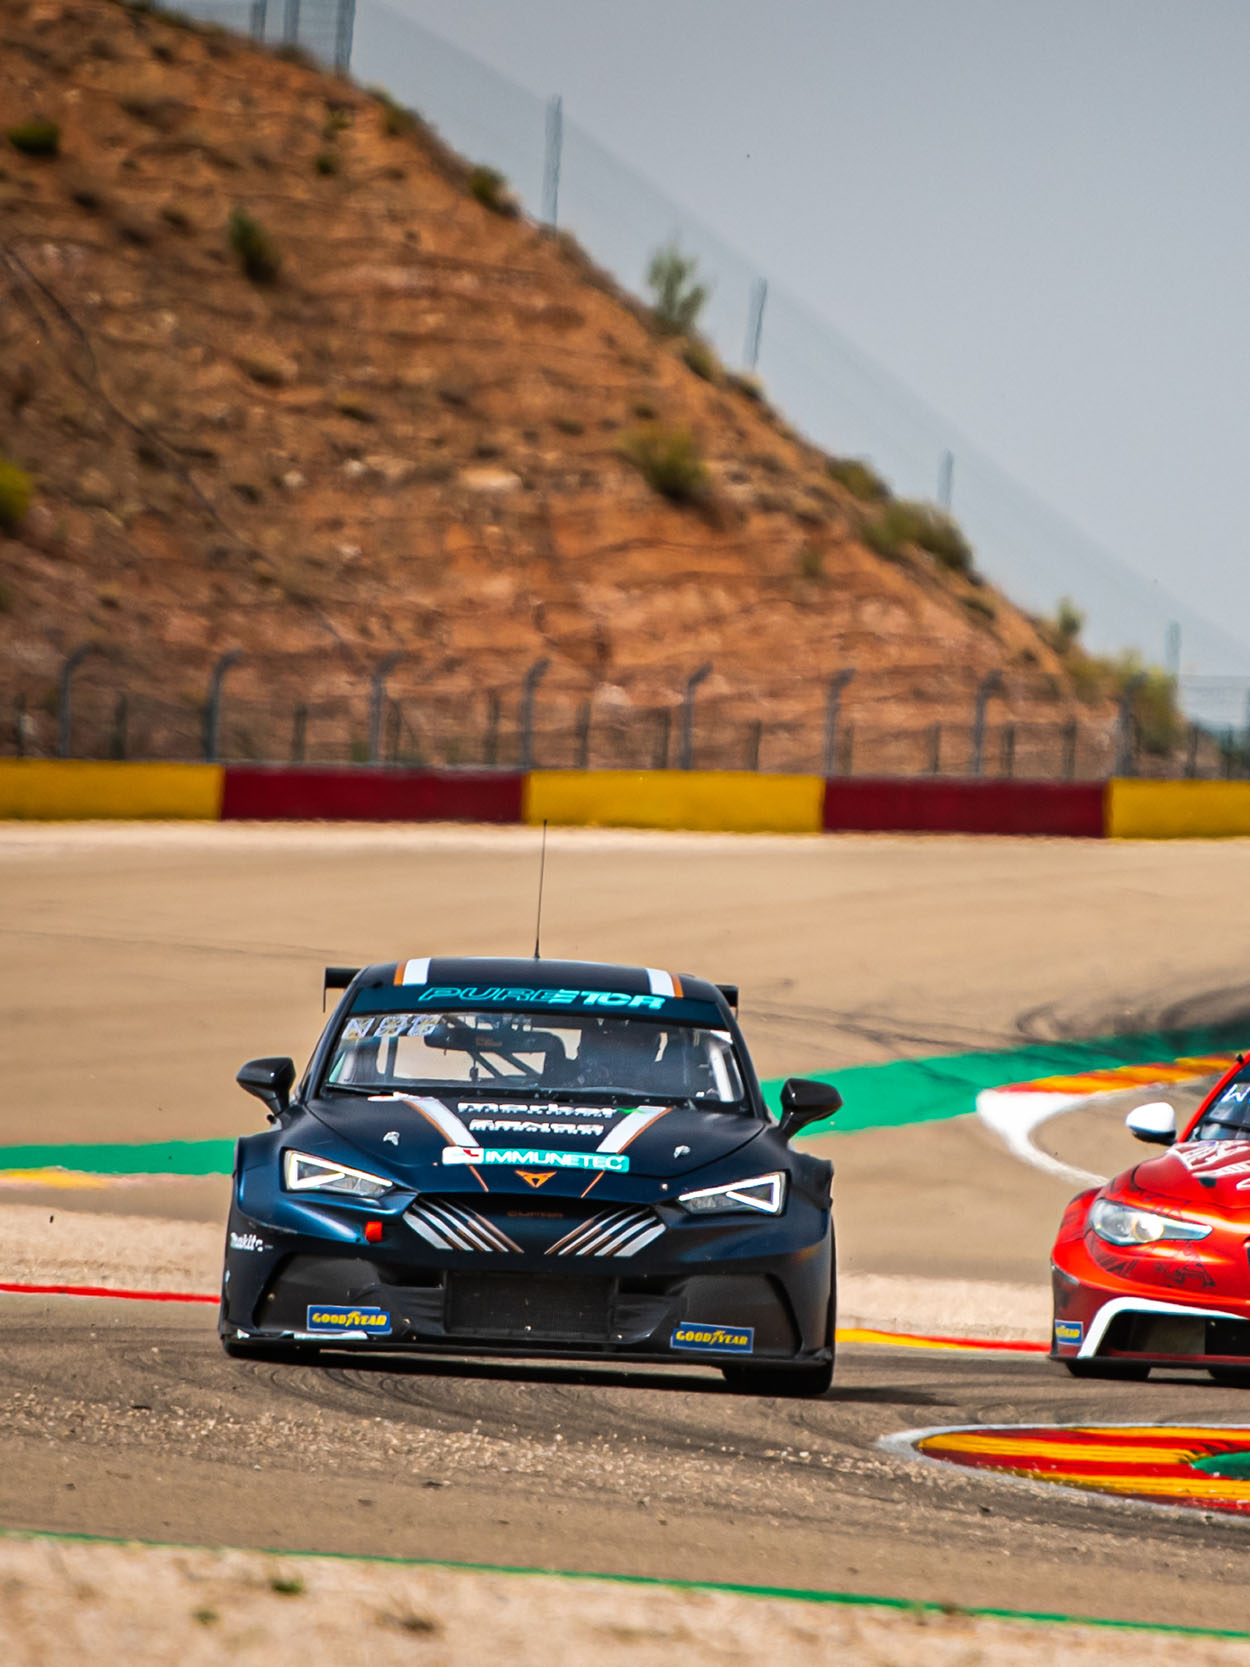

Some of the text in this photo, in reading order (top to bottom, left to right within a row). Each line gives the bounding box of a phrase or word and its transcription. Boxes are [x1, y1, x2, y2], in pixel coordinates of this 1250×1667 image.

[485, 1150, 625, 1170] IMMUNETEC
[311, 1310, 388, 1328] GOODYEAR
[675, 1329, 749, 1346] GOODYEAR
